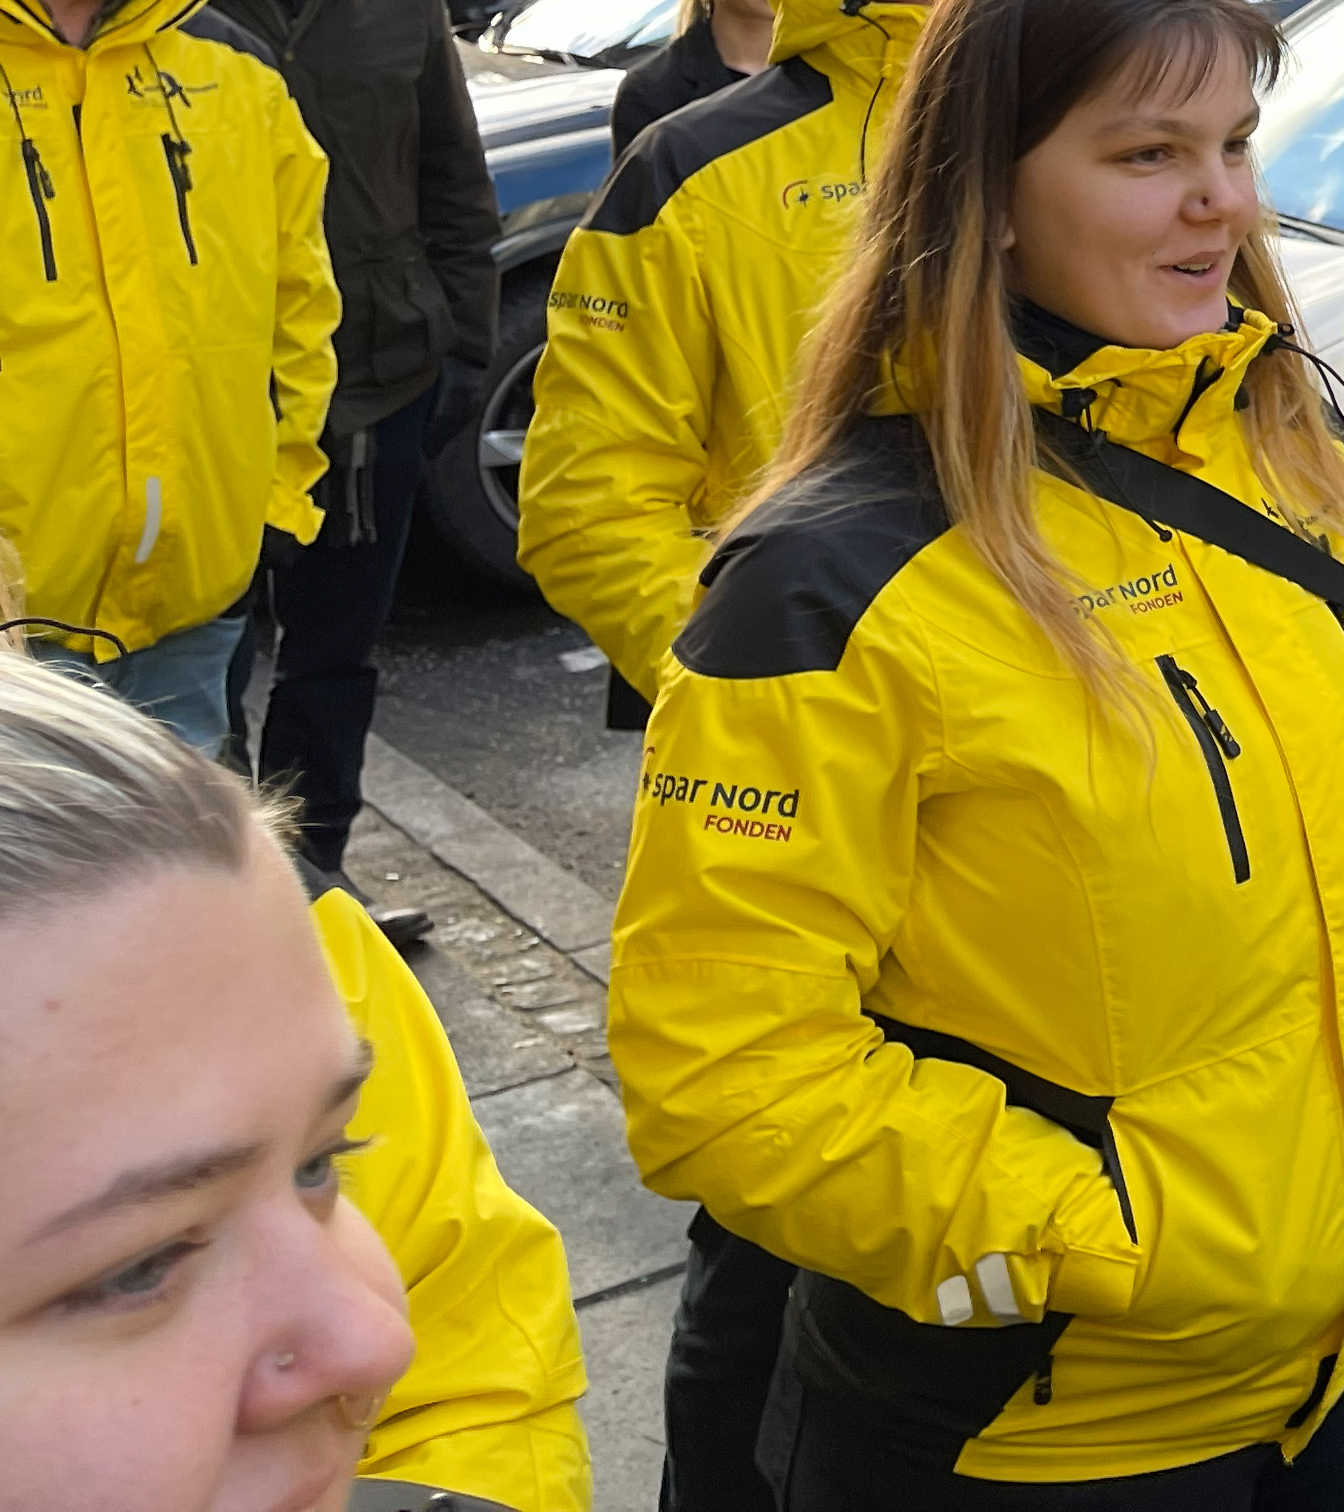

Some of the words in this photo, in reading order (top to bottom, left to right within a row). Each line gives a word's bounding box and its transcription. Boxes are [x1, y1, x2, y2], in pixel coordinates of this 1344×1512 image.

[821, 181, 861, 203] spa
[579, 294, 628, 319] Nord
[1074, 586, 1116, 619] par
[1118, 562, 1179, 600] Nord
[1130, 591, 1183, 615] FONDEN
[652, 772, 708, 806] spar
[710, 782, 800, 818] Nord
[704, 814, 792, 842] FONDEN
